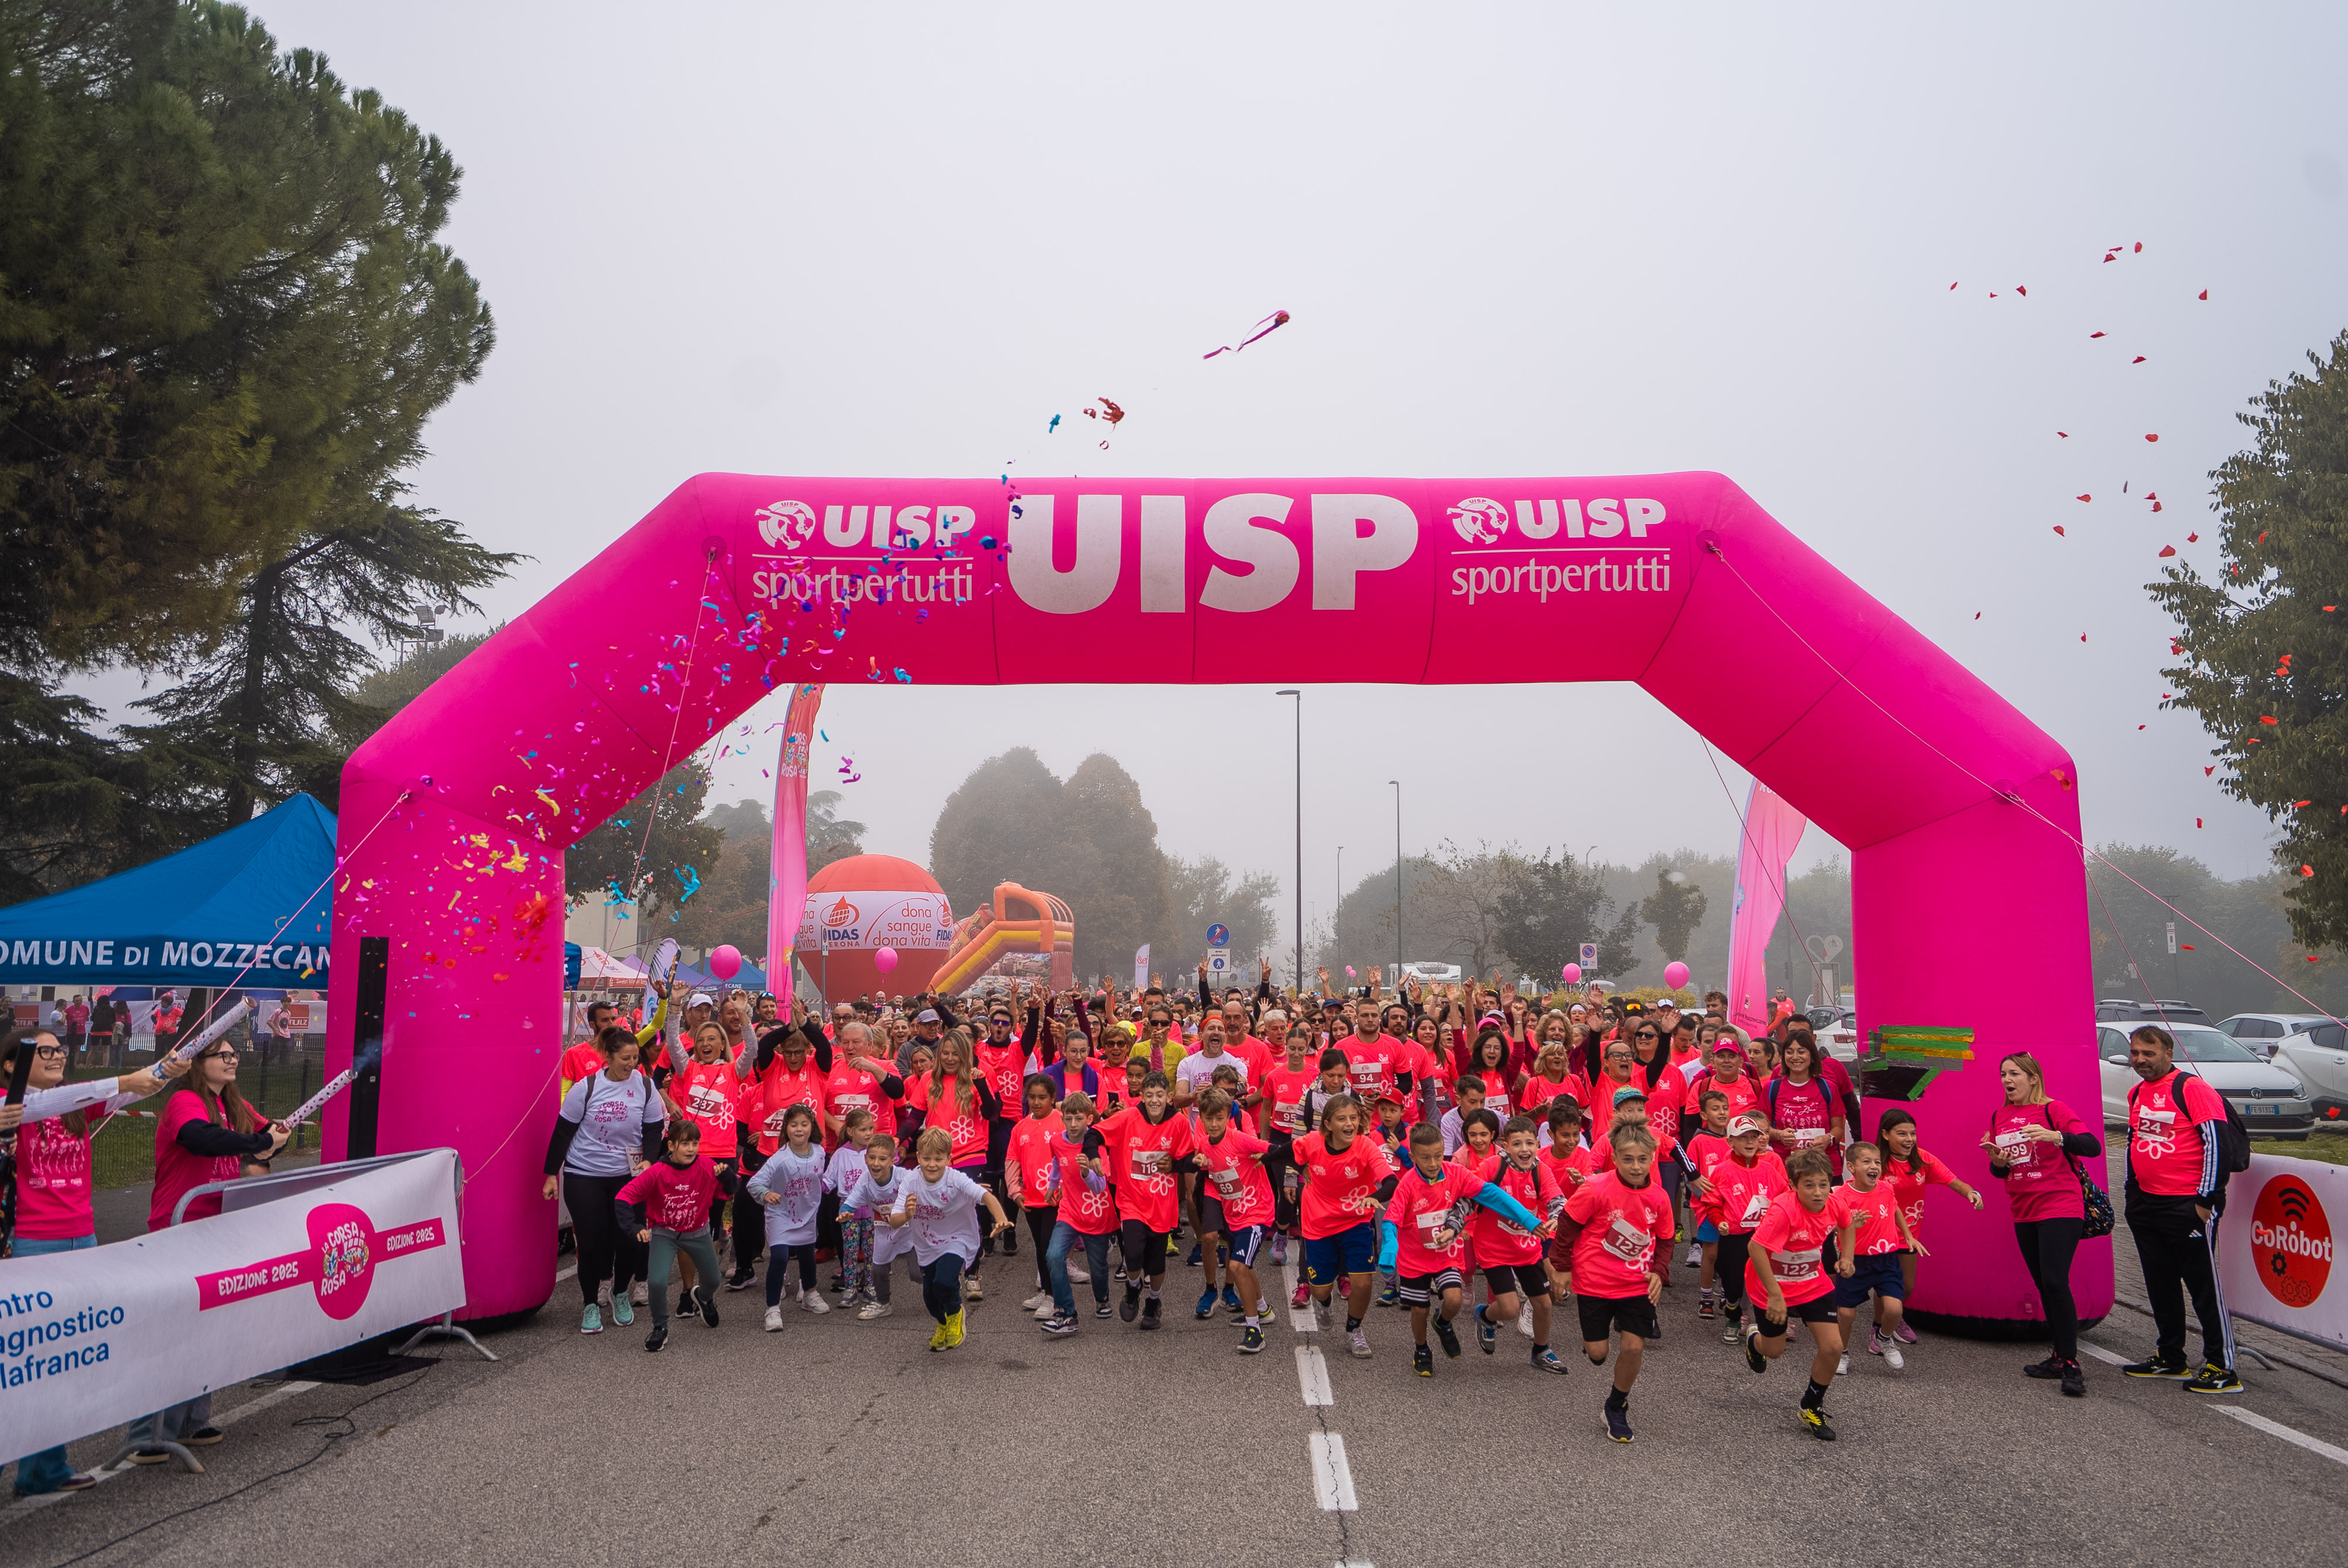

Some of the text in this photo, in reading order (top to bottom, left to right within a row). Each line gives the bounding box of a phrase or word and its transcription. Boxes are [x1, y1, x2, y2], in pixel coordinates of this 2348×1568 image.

[1515, 498, 1666, 539] UISP
[823, 505, 976, 548] UISP
[1007, 492, 1419, 614] UISP
[752, 563, 973, 610] sportpertutti
[1451, 554, 1671, 605] sportpertutti
[781, 763, 797, 777] ROSA
[803, 910, 815, 920] na
[902, 902, 932, 918] dona
[799, 924, 814, 938] gue
[827, 928, 859, 941] IDAS
[888, 922, 932, 935] sangue
[936, 929, 952, 941] FIDAS
[803, 937, 817, 948] vita
[873, 930, 930, 946] dona vita
[124, 946, 149, 966] DI
[161, 942, 331, 970] MOZZECAN
[1359, 1073, 1374, 1083] 94
[691, 1098, 716, 1111] 237
[594, 1114, 612, 1123] ROSA
[1283, 1113, 1296, 1122] 95
[771, 1120, 784, 1130] 72
[2140, 1119, 2161, 1134] 24
[1141, 1163, 1158, 1174] 116
[1220, 1182, 1233, 1193] 69
[321, 1221, 365, 1253] LA CORSA IN
[386, 1226, 435, 1252] EDIZIONE 2025
[2251, 1220, 2332, 1262] CoRobot
[1615, 1235, 1642, 1255] 123
[1782, 1263, 1810, 1275] 122
[218, 1262, 299, 1296] EDIZIONE 2025
[321, 1269, 346, 1296] ROSA
